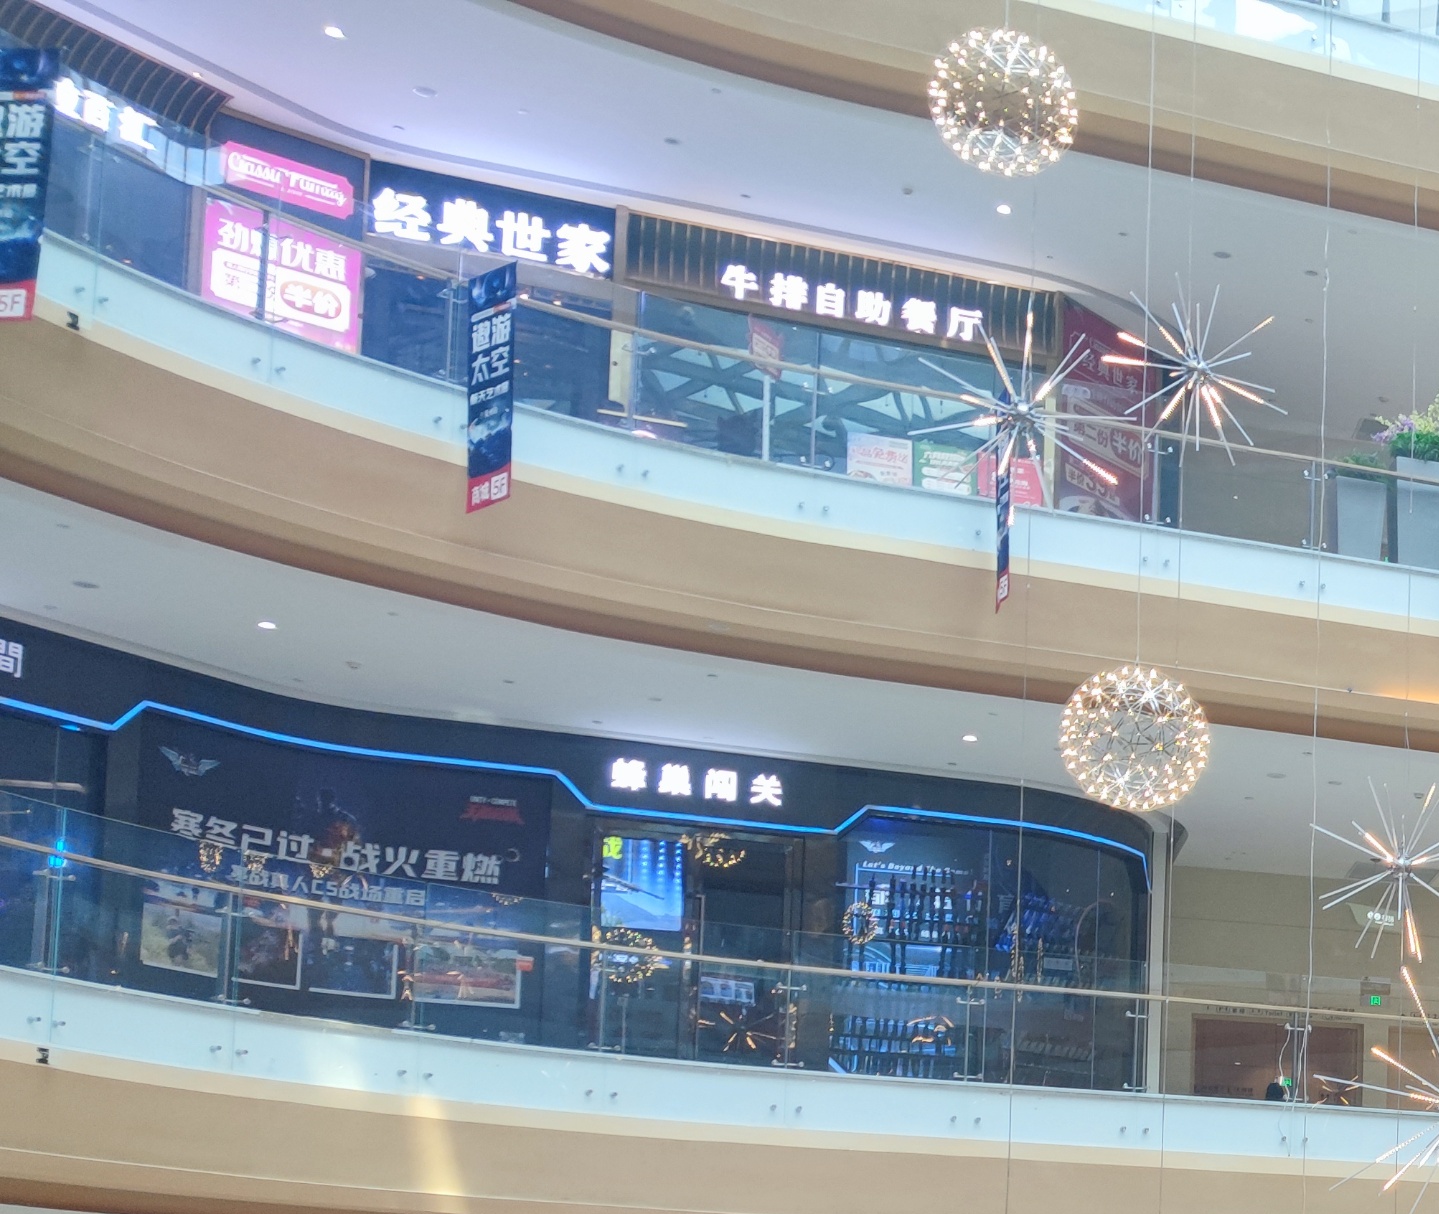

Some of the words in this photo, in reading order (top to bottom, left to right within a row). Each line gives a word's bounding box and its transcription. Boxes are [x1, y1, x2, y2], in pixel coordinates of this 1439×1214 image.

[371, 186, 610, 274] 经典世家
[283, 286, 341, 319] 半价
[721, 264, 983, 341] 牛排自助餐厅
[1083, 353, 1138, 394] 经典世家
[1111, 429, 1143, 465] 半价
